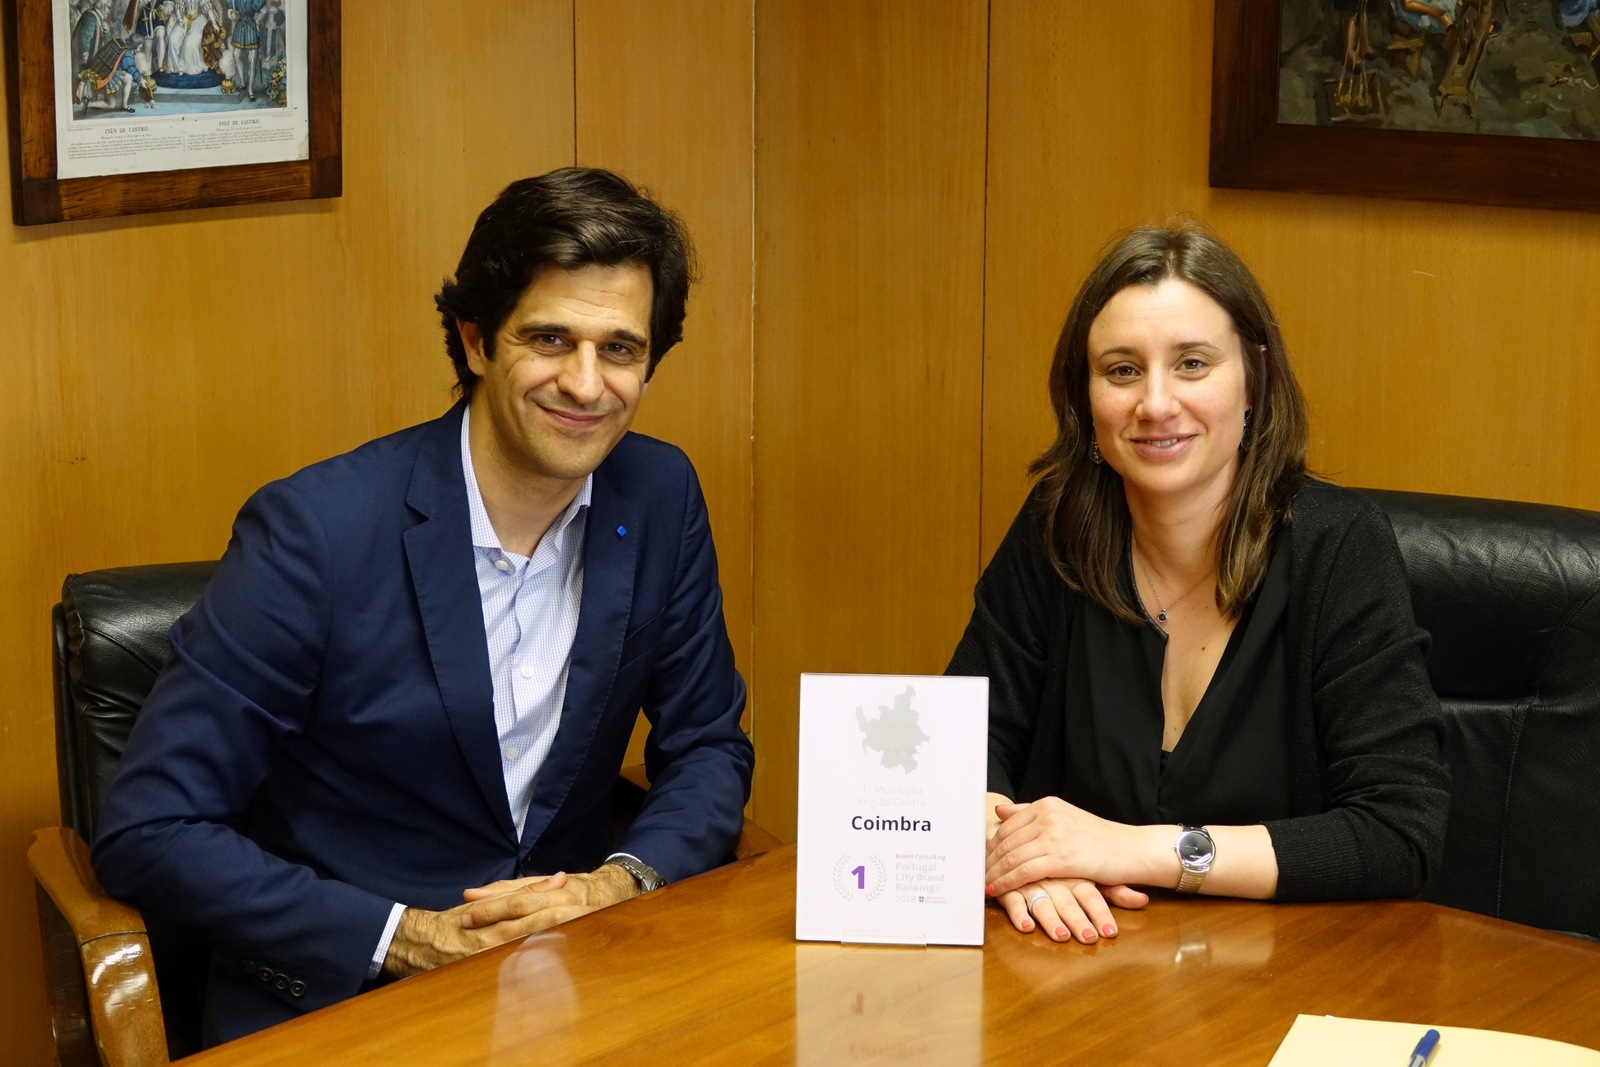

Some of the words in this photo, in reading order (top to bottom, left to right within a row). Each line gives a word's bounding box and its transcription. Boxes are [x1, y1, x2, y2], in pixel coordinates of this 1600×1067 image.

[856, 797, 890, 808] Região
[893, 798, 927, 807] Centro
[851, 815, 932, 832] Coimbra
[914, 853, 946, 862] Consulting
[895, 862, 937, 873] Portugal
[851, 865, 866, 890] 1
[895, 873, 915, 883] City
[917, 873, 945, 882] Brand
[895, 895, 916, 904] 2018
